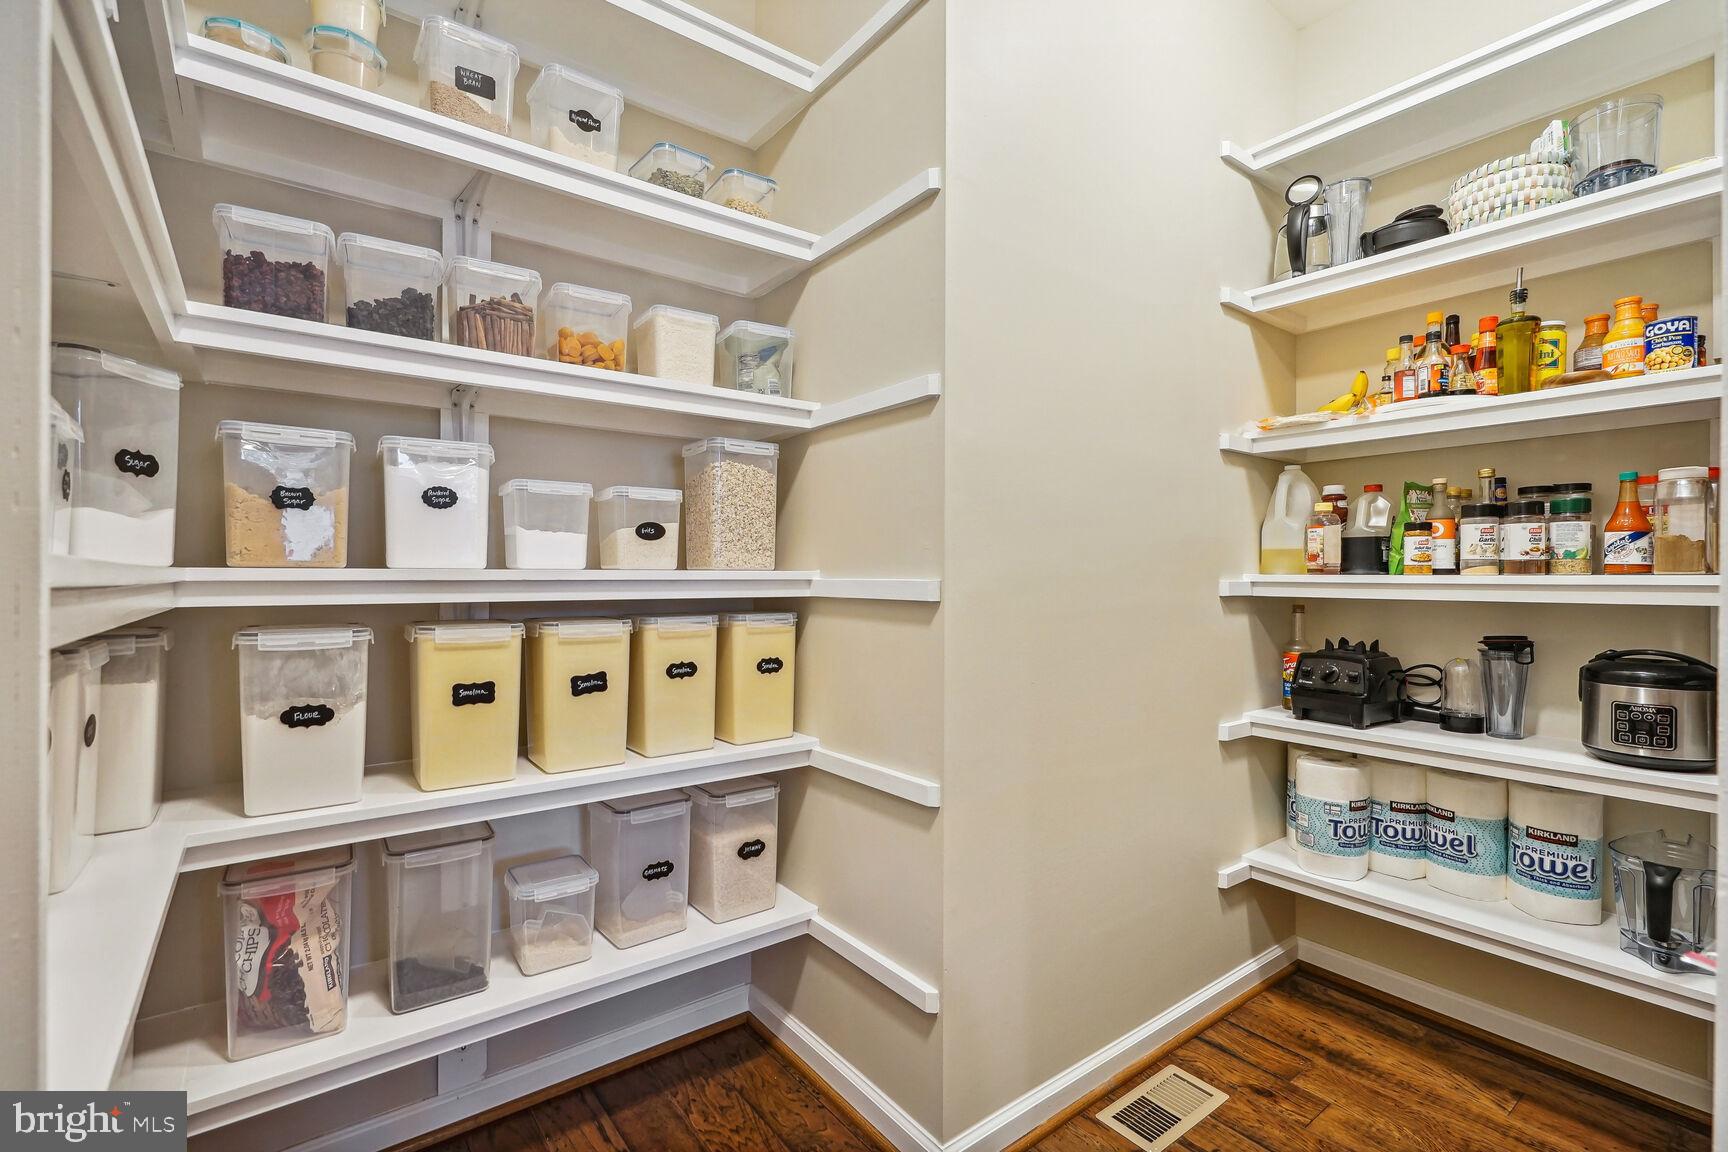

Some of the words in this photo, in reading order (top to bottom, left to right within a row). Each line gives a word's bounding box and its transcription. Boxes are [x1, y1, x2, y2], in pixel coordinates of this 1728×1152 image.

[460, 68, 482, 80] WHEAT
[463, 77, 481, 88] BRAN
[1646, 320, 1691, 337] GOYA
[124, 455, 151, 469] Sugar
[1629, 705, 1656, 713] AROMA
[1390, 819, 1425, 827] PREMIU
[1528, 827, 1577, 842] KIRKLAND
[1427, 829, 1477, 858] wel
[1525, 845, 1578, 861] PREMIUM
[1511, 840, 1597, 882] Towel
[242, 928, 261, 973] CHIPS
